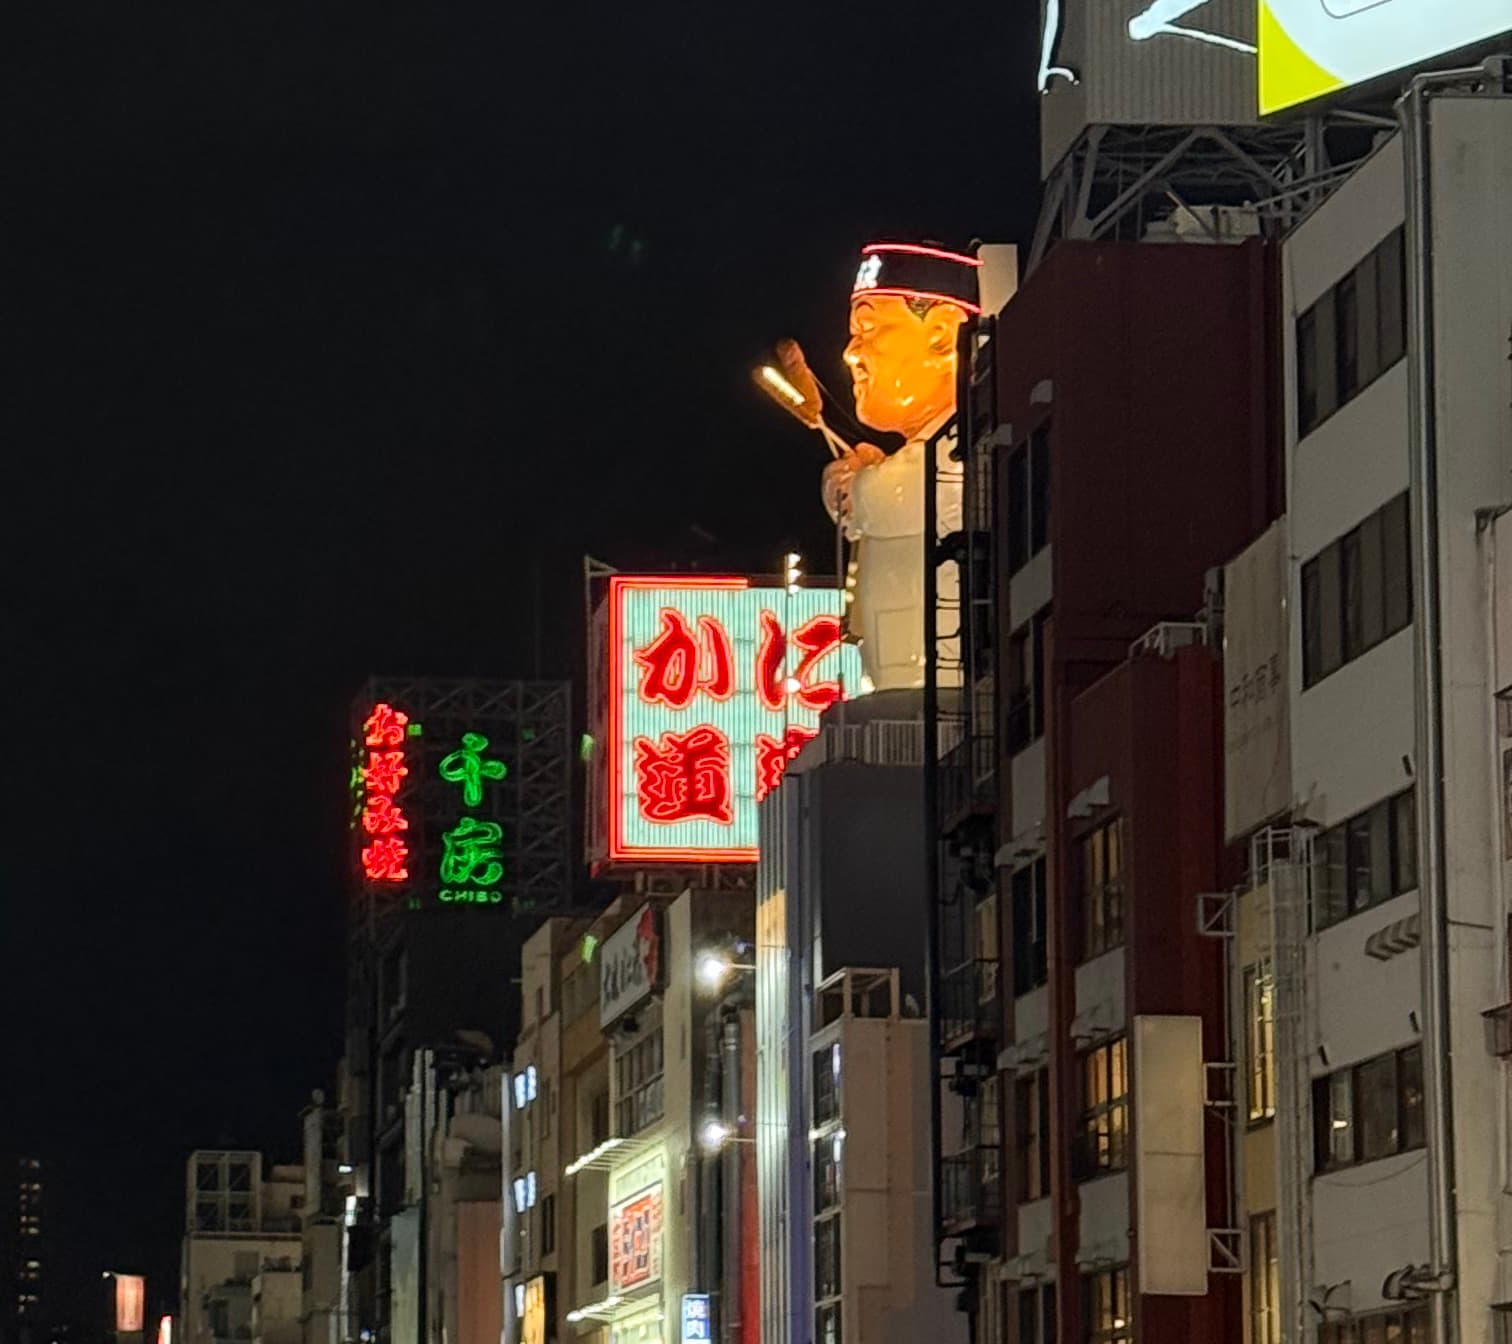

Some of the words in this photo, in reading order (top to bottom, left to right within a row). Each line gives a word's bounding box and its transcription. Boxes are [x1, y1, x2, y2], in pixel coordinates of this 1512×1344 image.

[632, 607, 845, 712] かに
[361, 703, 408, 882] お好み焼
[439, 889, 502, 902] CHIBO
